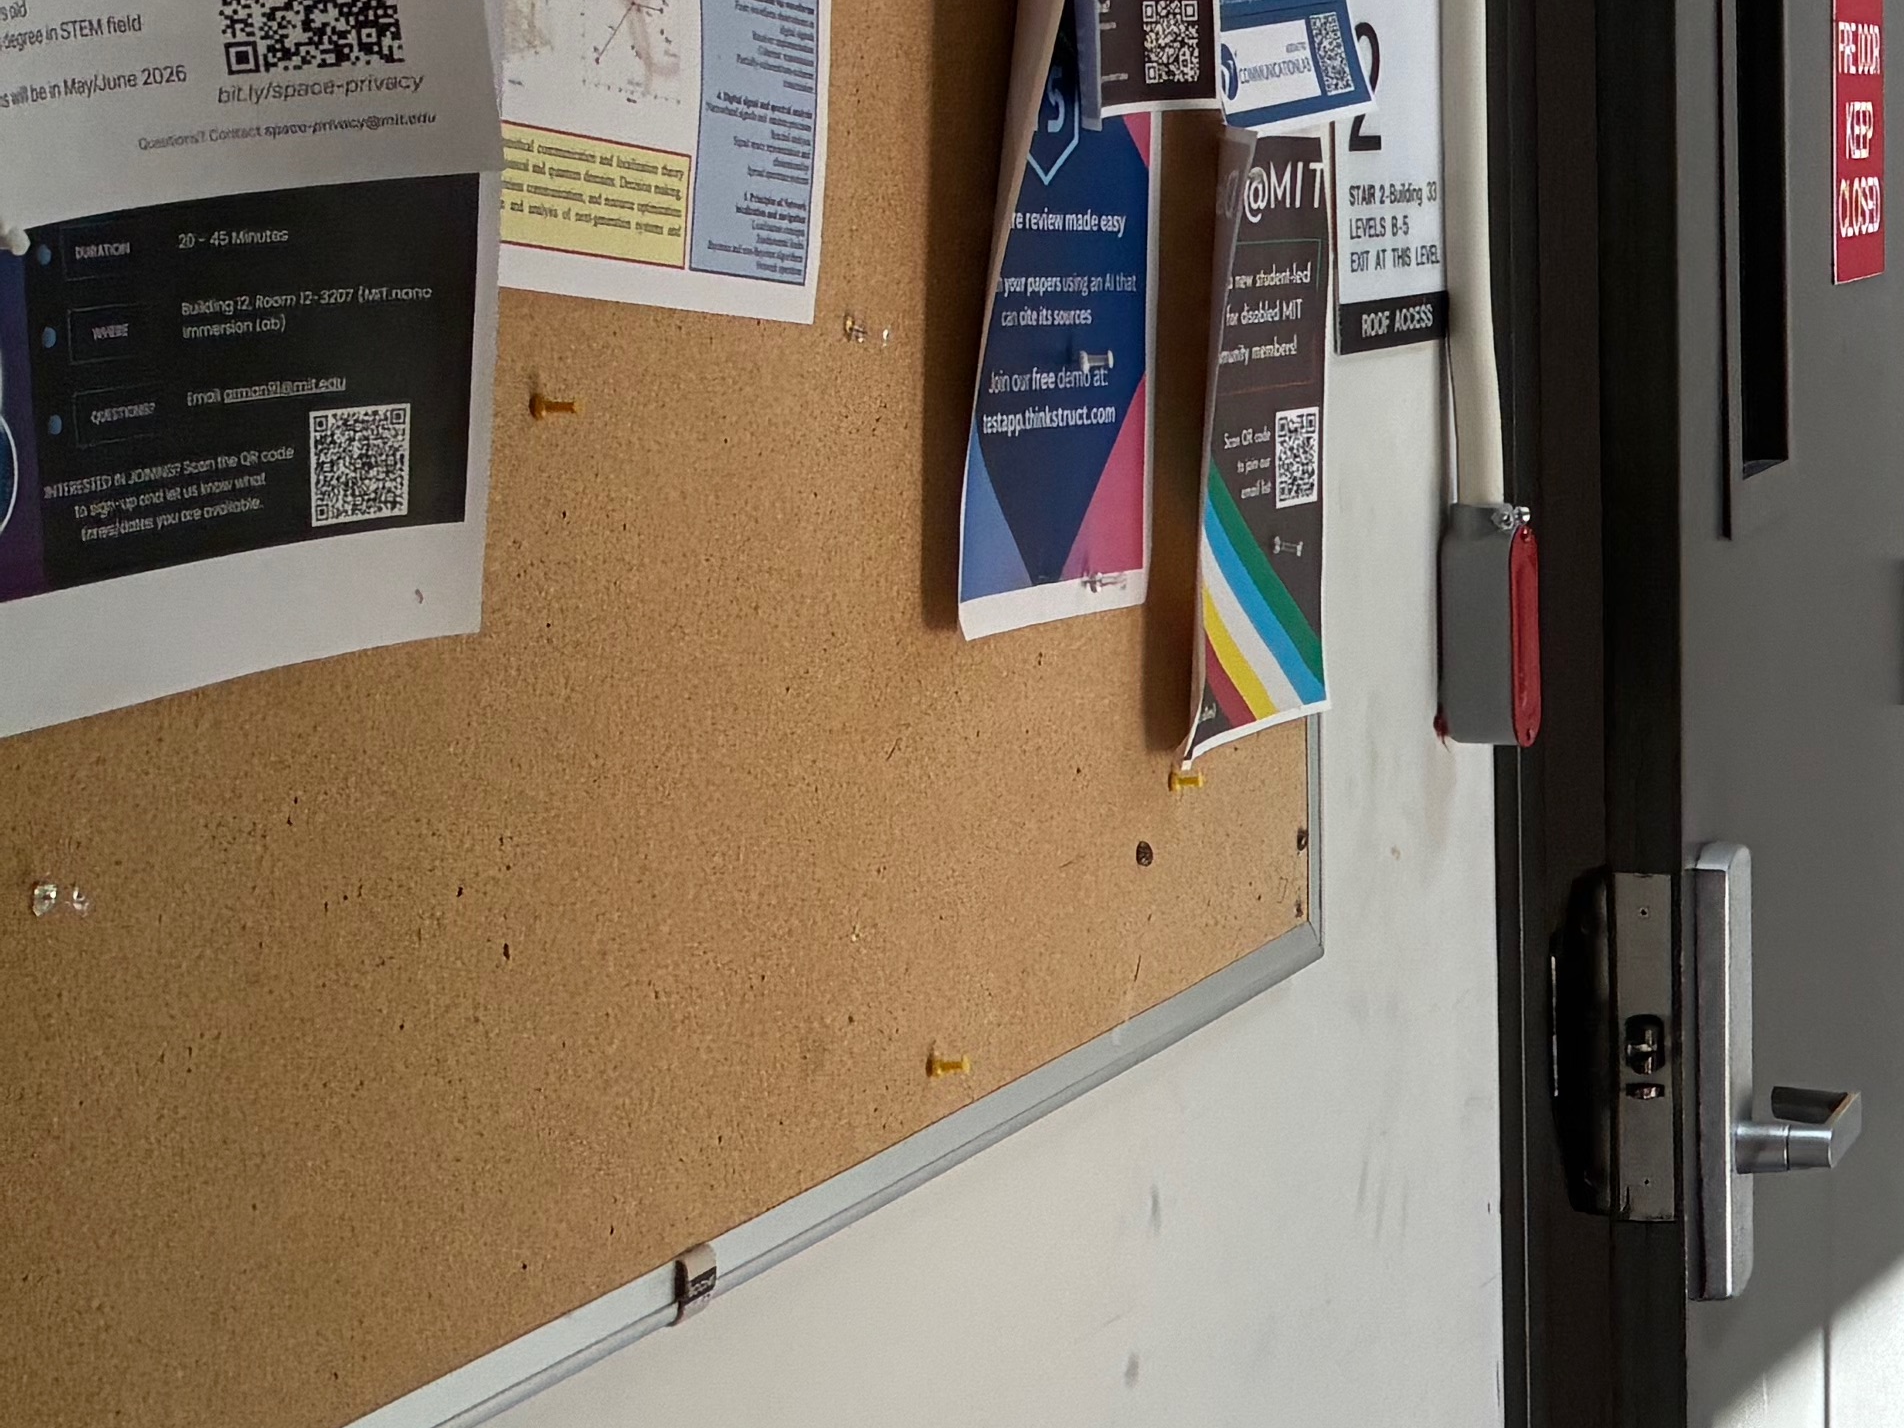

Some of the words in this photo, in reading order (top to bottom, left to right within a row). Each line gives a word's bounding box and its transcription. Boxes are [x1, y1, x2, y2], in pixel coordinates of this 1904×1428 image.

[60, 19, 104, 41] STEM
[106, 14, 142, 35] field
[140, 64, 187, 86] 2026
[1846, 101, 1873, 159] KEEP
[1244, 161, 1324, 223] @MIT
[1349, 184, 1375, 207] STAIR
[1025, 207, 1064, 231] review
[1065, 209, 1099, 231] made
[1100, 215, 1127, 238] easy
[1349, 216, 1387, 240] LEVELS
[231, 229, 289, 245] Minutes
[1350, 250, 1370, 273] EXIT
[1375, 247, 1387, 271] AT
[1391, 246, 1412, 269] THIS
[1415, 244, 1440, 266] LEVEL
[1027, 277, 1062, 296] papers
[1062, 273, 1089, 296] using
[1090, 277, 1103, 292] an
[1116, 273, 1137, 292] that
[255, 294, 296, 309] Room
[1282, 299, 1303, 321] MIT
[1001, 310, 1018, 326] can
[1020, 306, 1037, 326] cite
[1039, 306, 1052, 325] its
[1053, 309, 1092, 325] sources
[1361, 310, 1390, 338] ROOF
[1394, 303, 1433, 332] ACCESS
[1011, 373, 1030, 392] our
[1031, 367, 1056, 390] free
[261, 445, 295, 463] code
